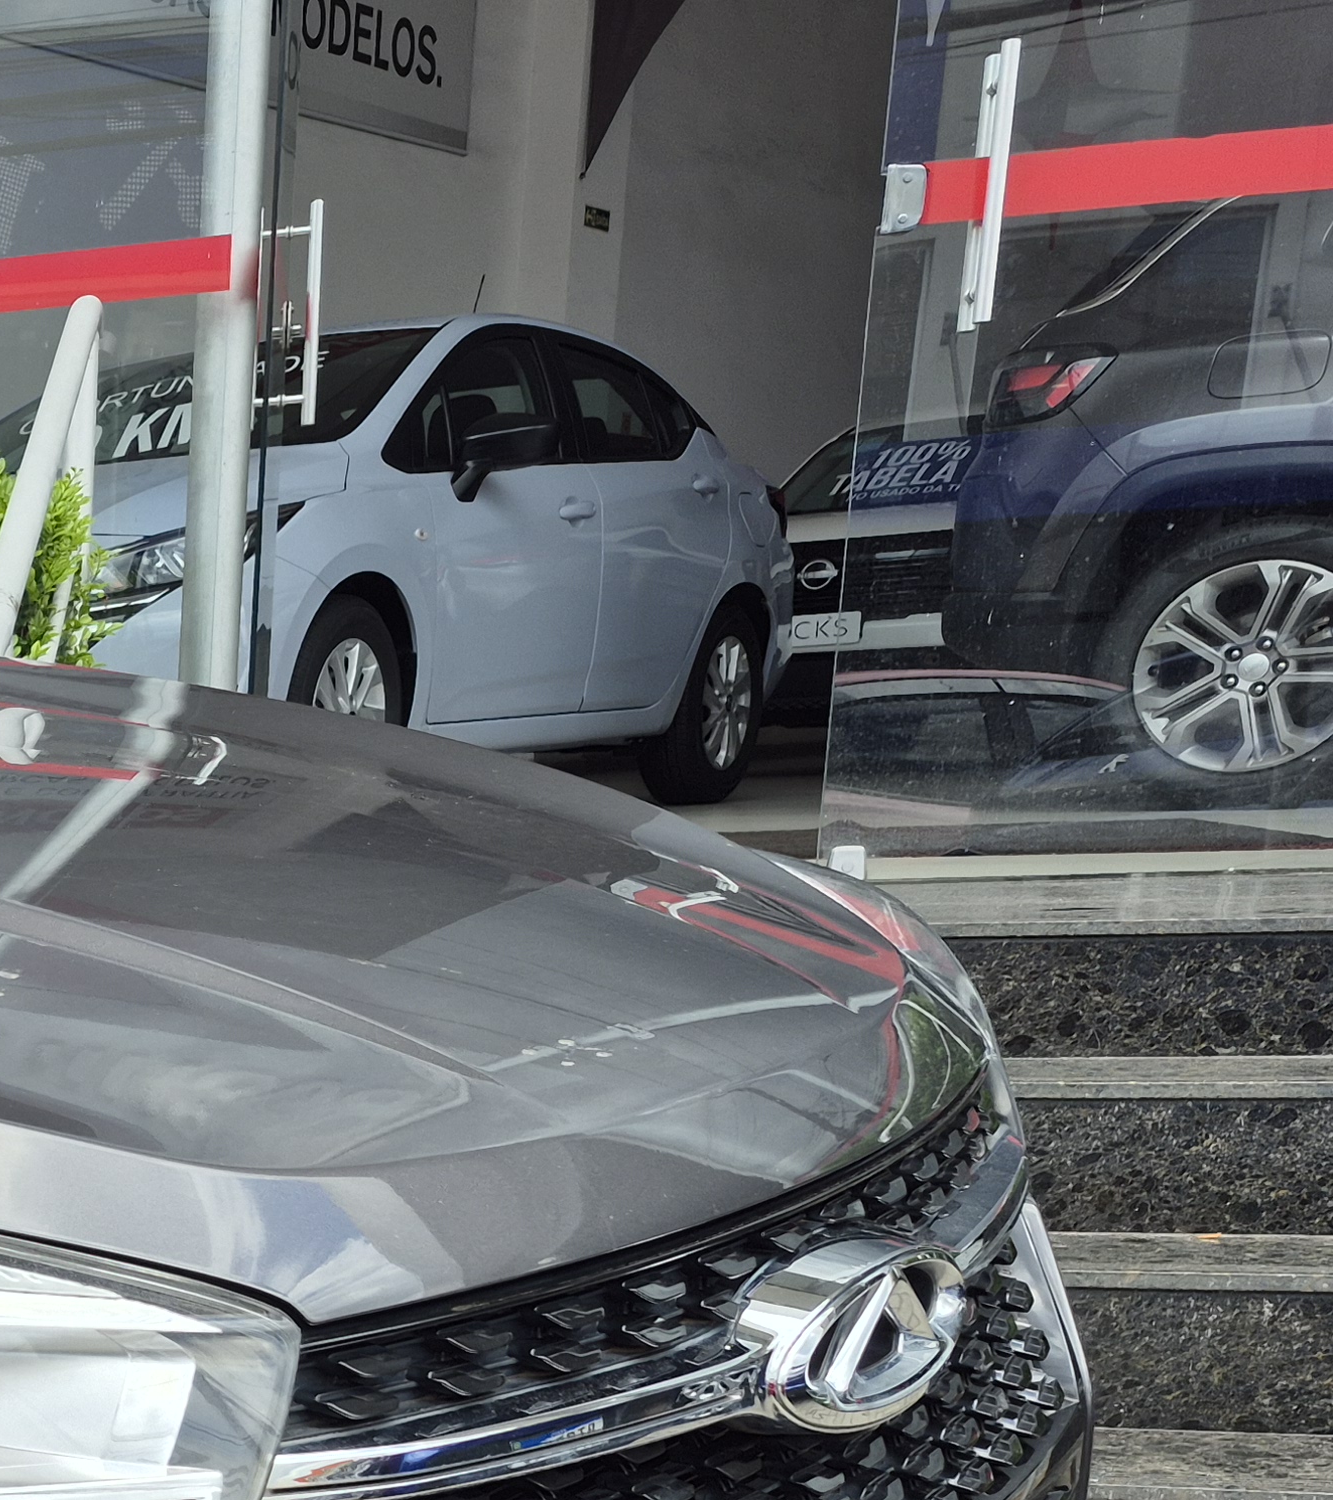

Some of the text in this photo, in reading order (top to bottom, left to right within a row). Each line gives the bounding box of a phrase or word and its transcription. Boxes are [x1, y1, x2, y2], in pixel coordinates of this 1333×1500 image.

[271, 0, 442, 88] ODELOS.
[872, 439, 972, 470] 100%
[829, 460, 960, 497] TABELA
[870, 484, 920, 500] USADO
[922, 483, 943, 494] DA
